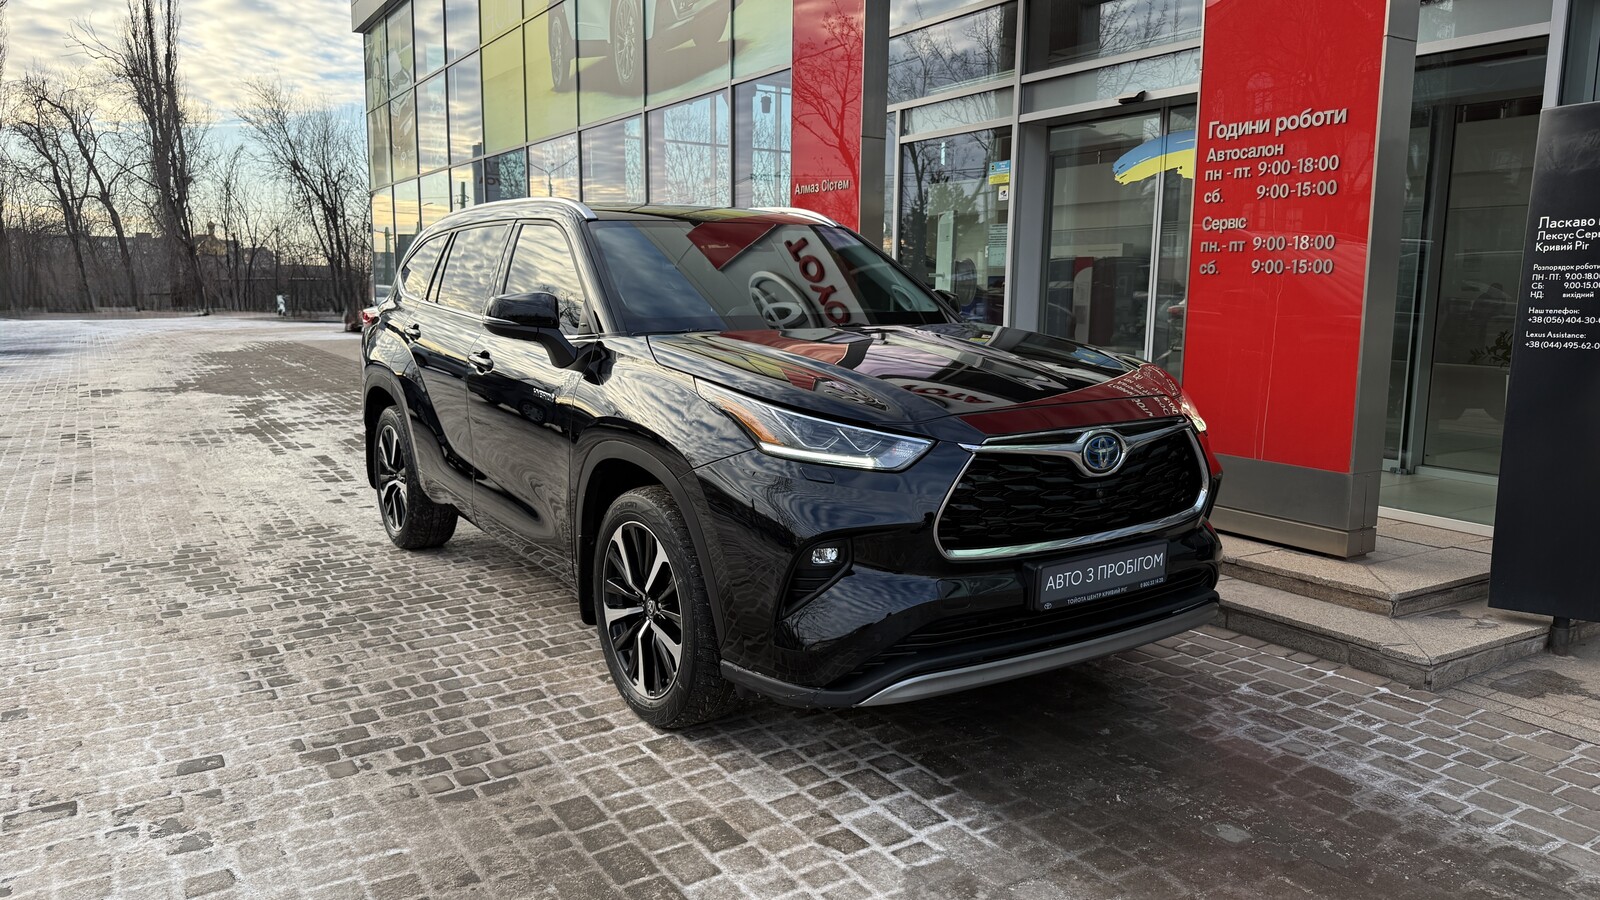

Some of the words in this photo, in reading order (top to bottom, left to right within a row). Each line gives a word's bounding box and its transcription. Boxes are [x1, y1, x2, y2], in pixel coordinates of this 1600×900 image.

[1208, 118, 1271, 140] Години
[1275, 108, 1348, 136] роботи
[1206, 144, 1285, 163] Автосалон
[795, 183, 820, 195] Алмаз
[1204, 188, 1224, 203] сб.
[1256, 179, 1338, 200] 9:00-15:00
[1202, 216, 1247, 233] Сервіс
[1538, 216, 1596, 229] Ласкаво
[1537, 231, 1575, 242] Лексус
[1535, 242, 1573, 253] Кривий
[1575, 240, 1590, 251] Ріг
[1199, 260, 1219, 275] сб.
[1251, 258, 1334, 274] 9:00-15:00
[1533, 263, 1575, 272] Розпорядок
[1531, 282, 1545, 290] СБ:
[1530, 291, 1545, 299] НД:
[1562, 291, 1595, 299] вихідний
[1545, 307, 1580, 315] телефон:
[1565, 316, 1600, 324] 404-30-
[1546, 331, 1587, 339] Assistance:
[1045, 570, 1083, 592] АВТО
[1097, 552, 1164, 580] ПРОБІГОМ
